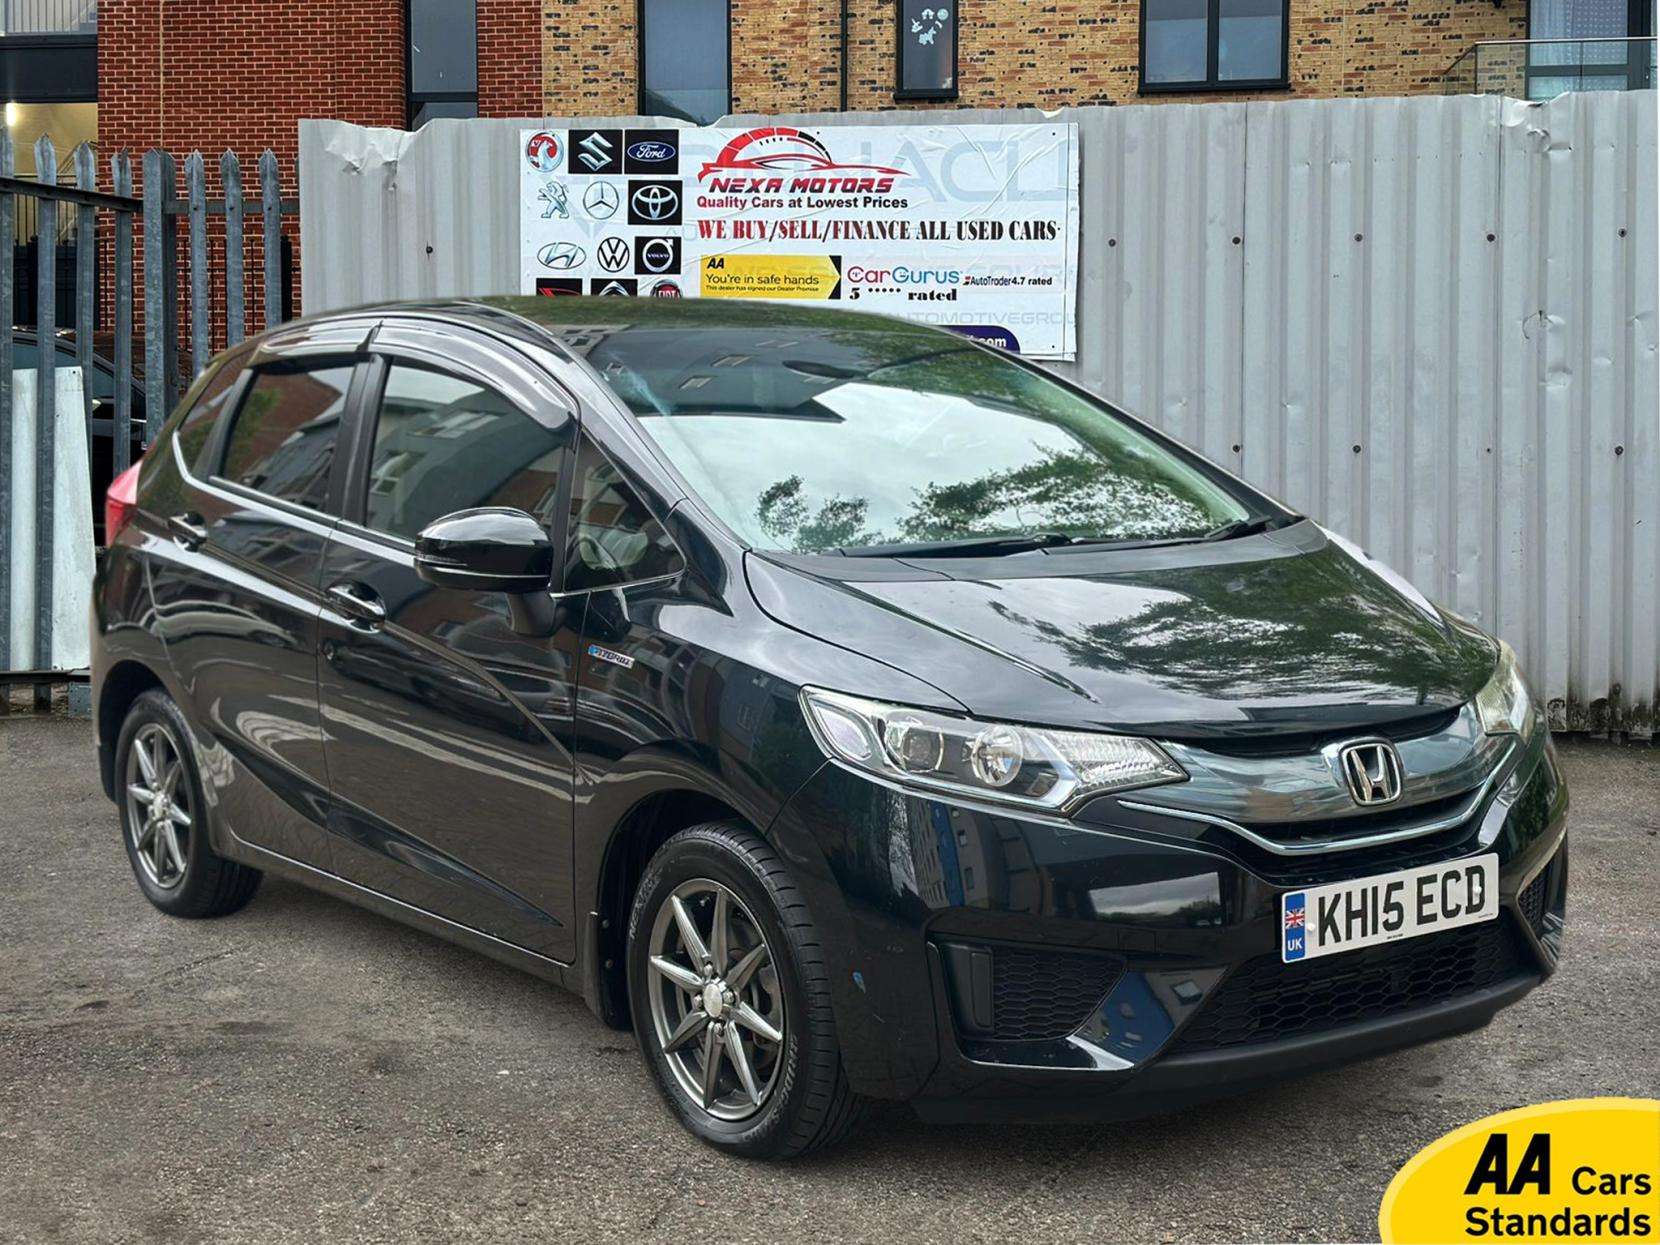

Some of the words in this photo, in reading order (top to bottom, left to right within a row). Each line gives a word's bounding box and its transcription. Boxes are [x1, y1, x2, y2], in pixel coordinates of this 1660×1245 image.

[636, 144, 667, 159] Ford
[709, 178, 784, 193] NEXA
[789, 178, 894, 193] MOTORS
[697, 196, 747, 210] Quality
[752, 196, 784, 209] Cars
[788, 197, 803, 209] at
[807, 197, 859, 209] Lowest
[863, 197, 908, 209] Prices
[698, 219, 727, 239] WE
[733, 219, 911, 243] BUY/SELL/FINANCE
[916, 220, 951, 240] ALL
[957, 220, 1004, 240] USED
[1009, 220, 1057, 240] CARS
[707, 257, 725, 269] AA
[706, 273, 741, 284] You're
[743, 274, 754, 284] in
[757, 273, 781, 285] safe
[784, 274, 820, 285] hands
[847, 266, 960, 284] CarGurus
[1028, 277, 1053, 286] rated
[849, 287, 861, 300] 5
[908, 288, 957, 301] rated
[1318, 880, 1404, 947] KH15
[1416, 864, 1486, 926] ECD
[1287, 937, 1303, 951] UK
